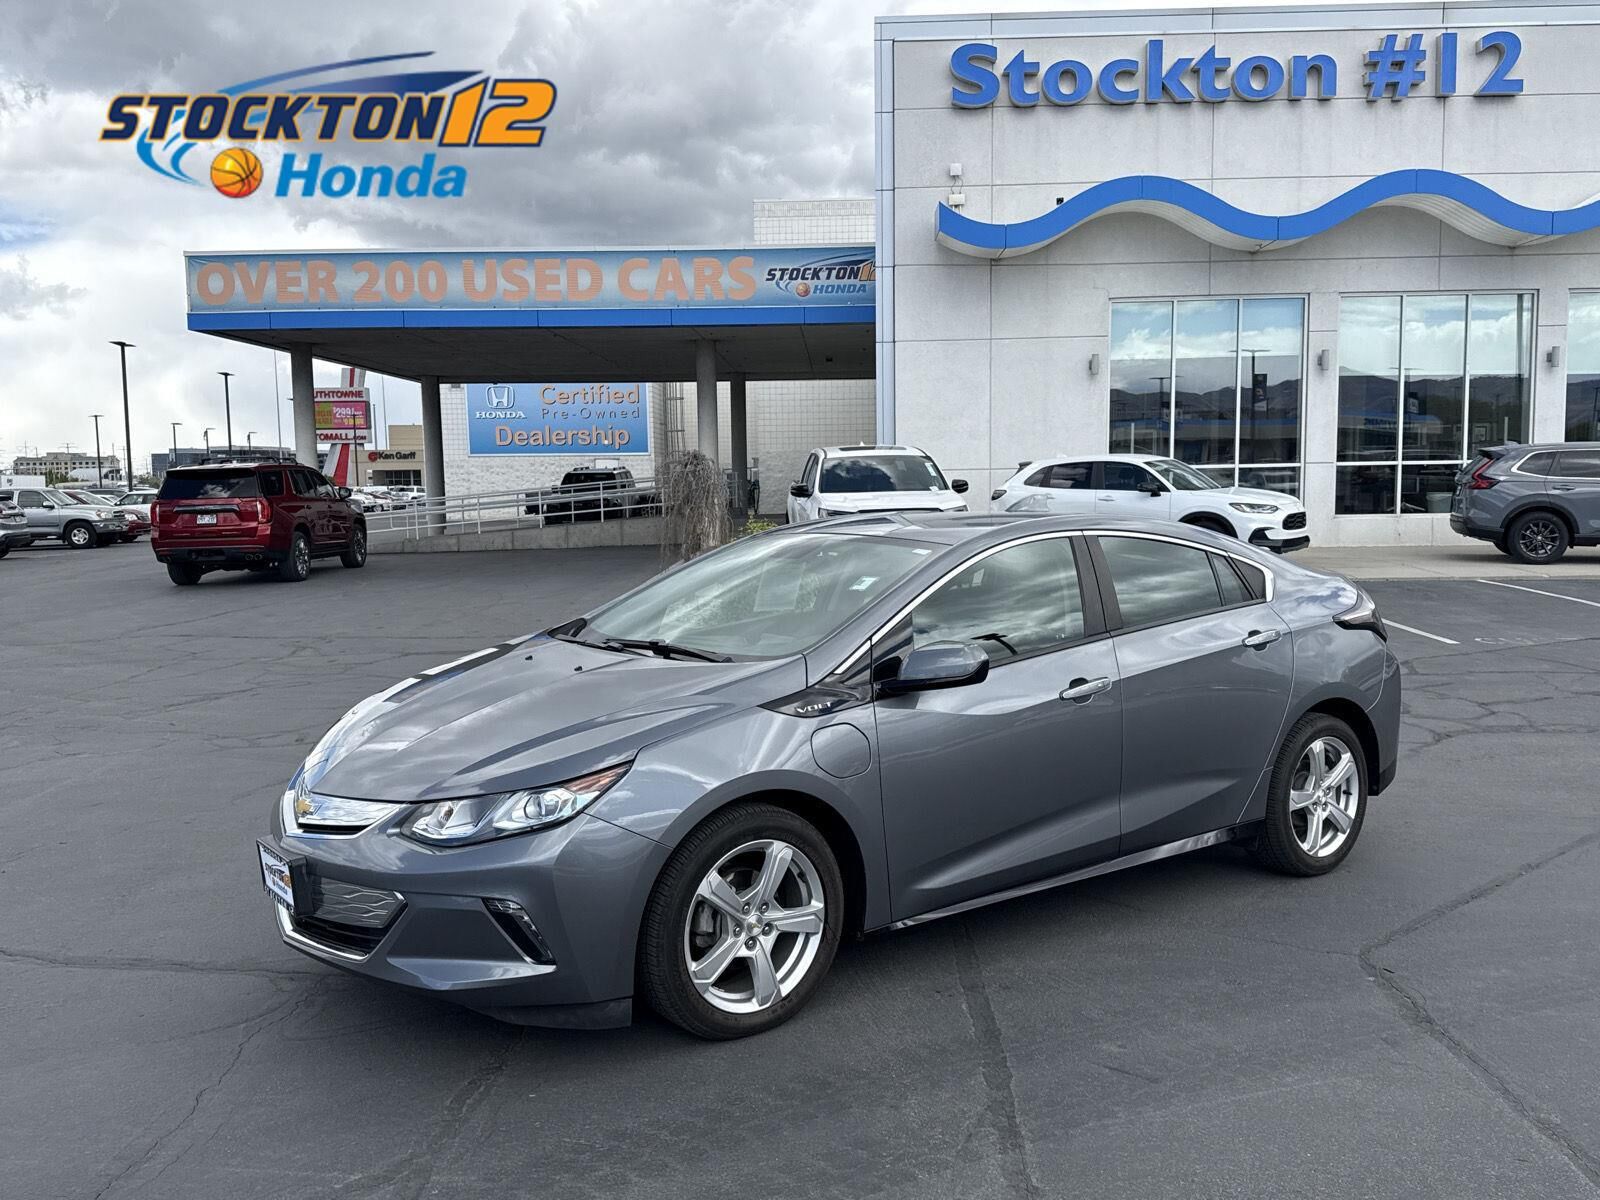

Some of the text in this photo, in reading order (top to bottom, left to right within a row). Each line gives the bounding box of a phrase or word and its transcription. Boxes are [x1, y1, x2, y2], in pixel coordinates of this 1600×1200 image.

[950, 30, 1525, 108] Stockton #12
[196, 255, 758, 306] OVER 200 USED CARS
[812, 284, 867, 294] HONDA
[314, 390, 364, 399] UTHTOWNE
[539, 384, 641, 405] Certified
[475, 410, 527, 420] HONDA
[541, 407, 641, 420] Pre-Owned
[495, 425, 631, 450] Dealership
[379, 451, 416, 460] Ken Garff
[797, 701, 832, 712] VOLT
